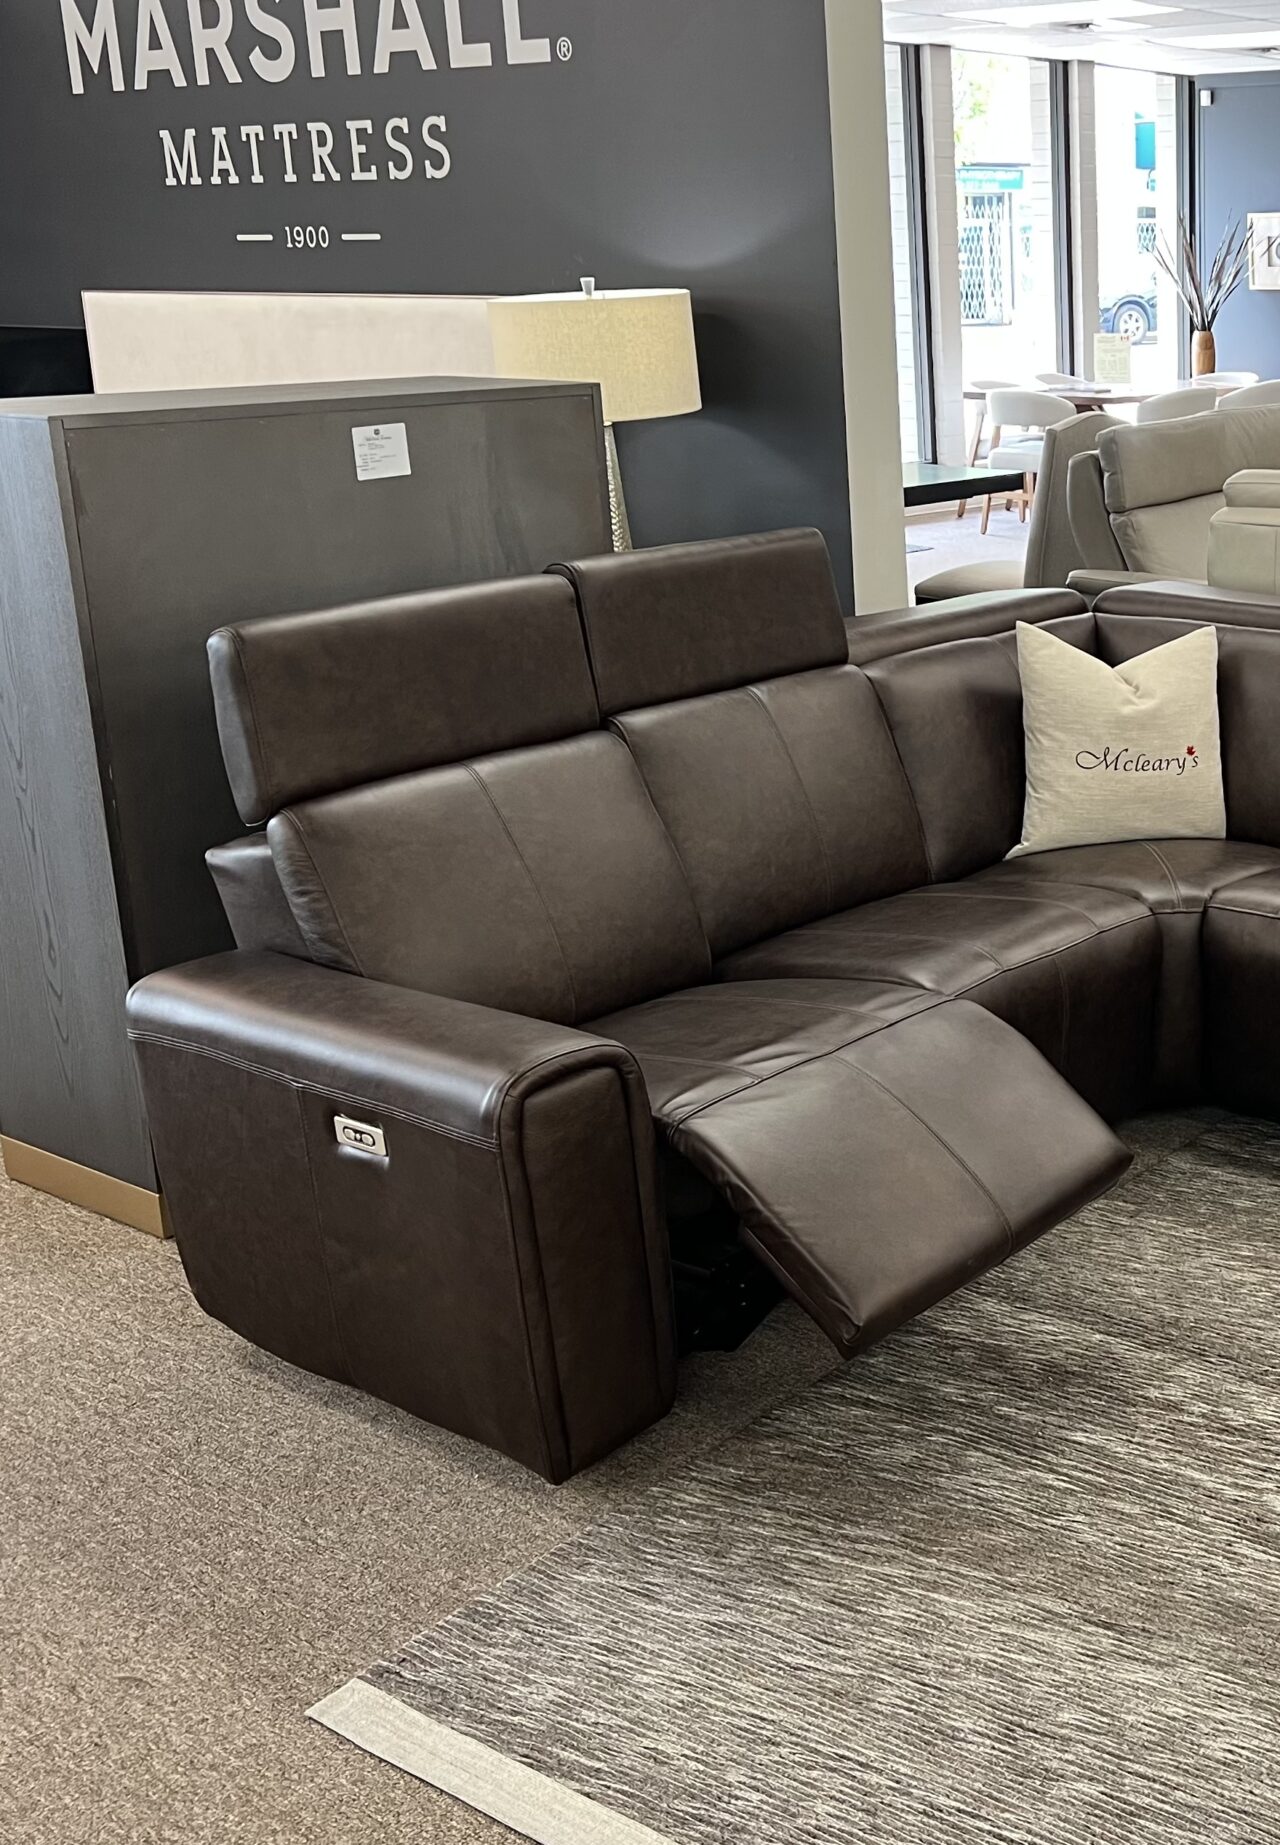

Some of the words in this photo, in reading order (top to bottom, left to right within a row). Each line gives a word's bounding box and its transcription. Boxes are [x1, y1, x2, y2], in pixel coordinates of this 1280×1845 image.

[159, 115, 452, 186] MATTRESS
[284, 225, 330, 249] 1900
[1075, 746, 1199, 776] Mcleary's
